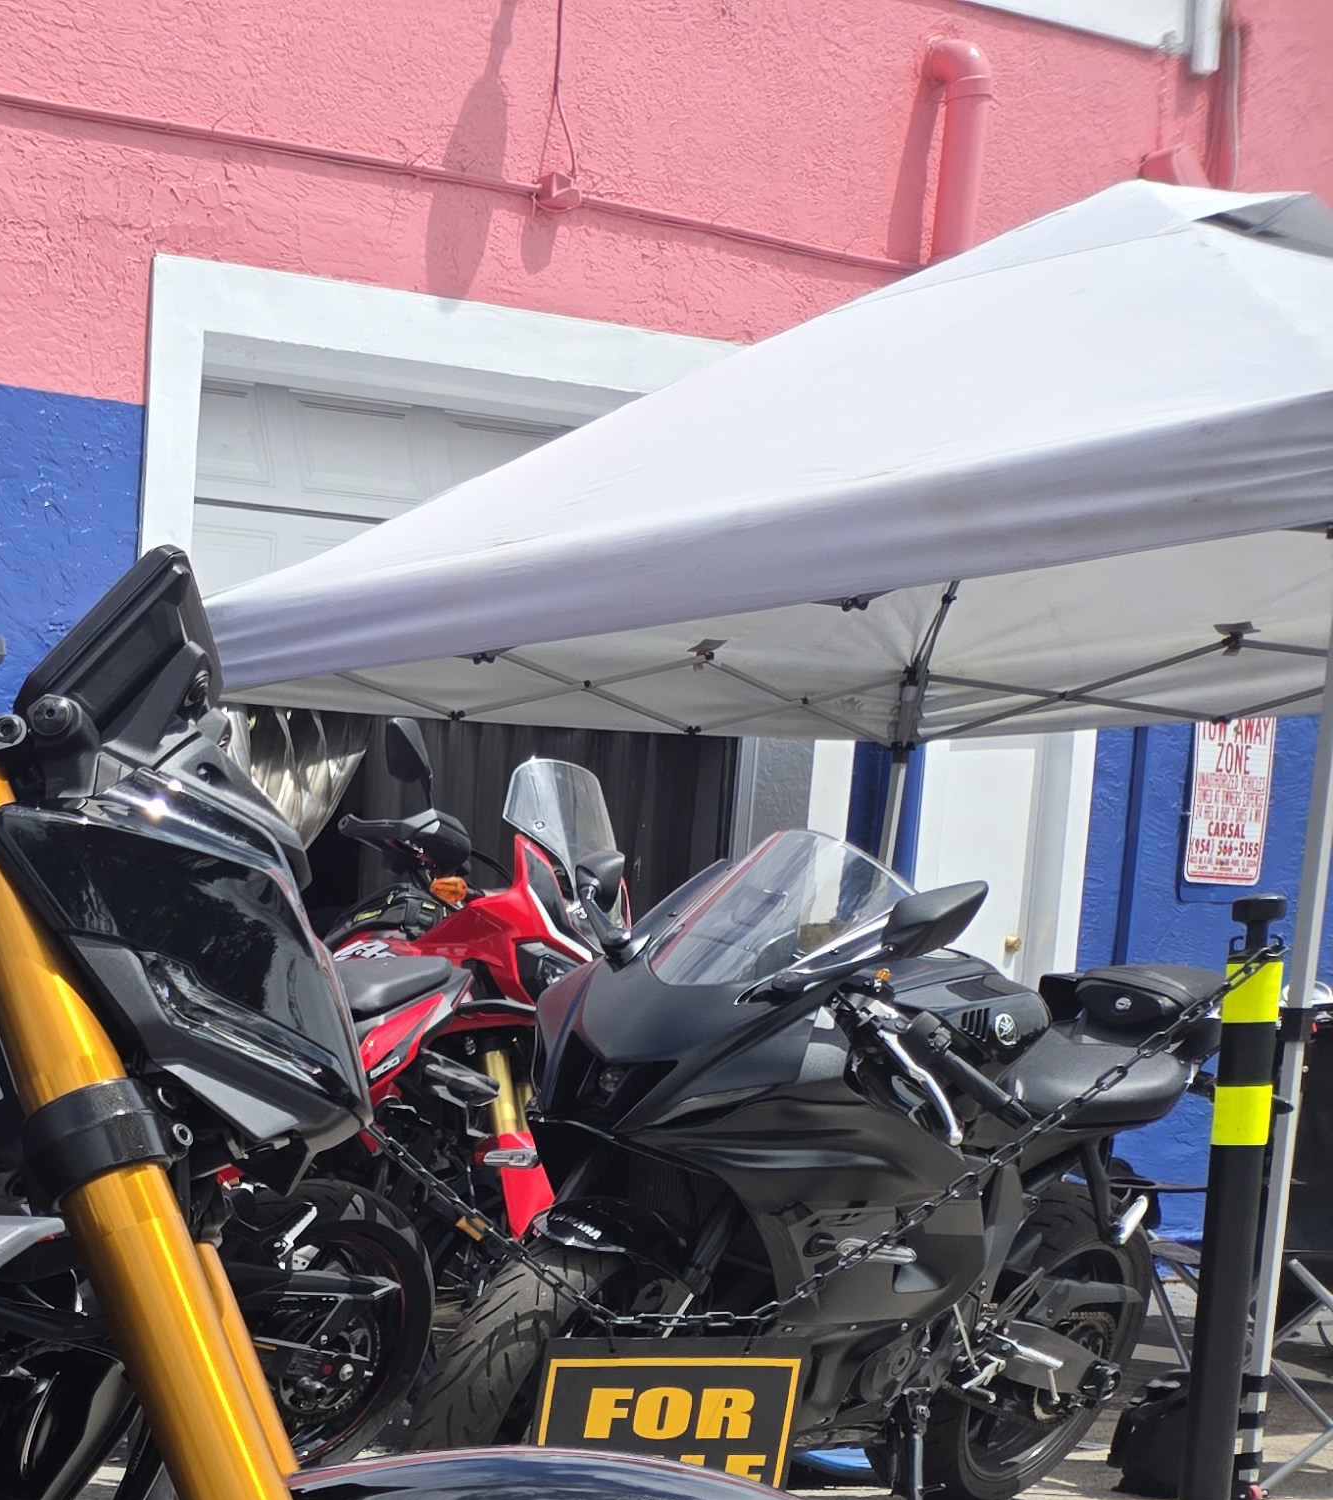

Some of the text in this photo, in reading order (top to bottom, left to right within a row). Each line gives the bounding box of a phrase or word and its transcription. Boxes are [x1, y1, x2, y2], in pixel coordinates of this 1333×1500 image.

[1234, 717, 1270, 745] AWAY
[1215, 742, 1252, 775] ZONE
[1207, 821, 1246, 839] CARSAL
[583, 1386, 756, 1440] FOR
